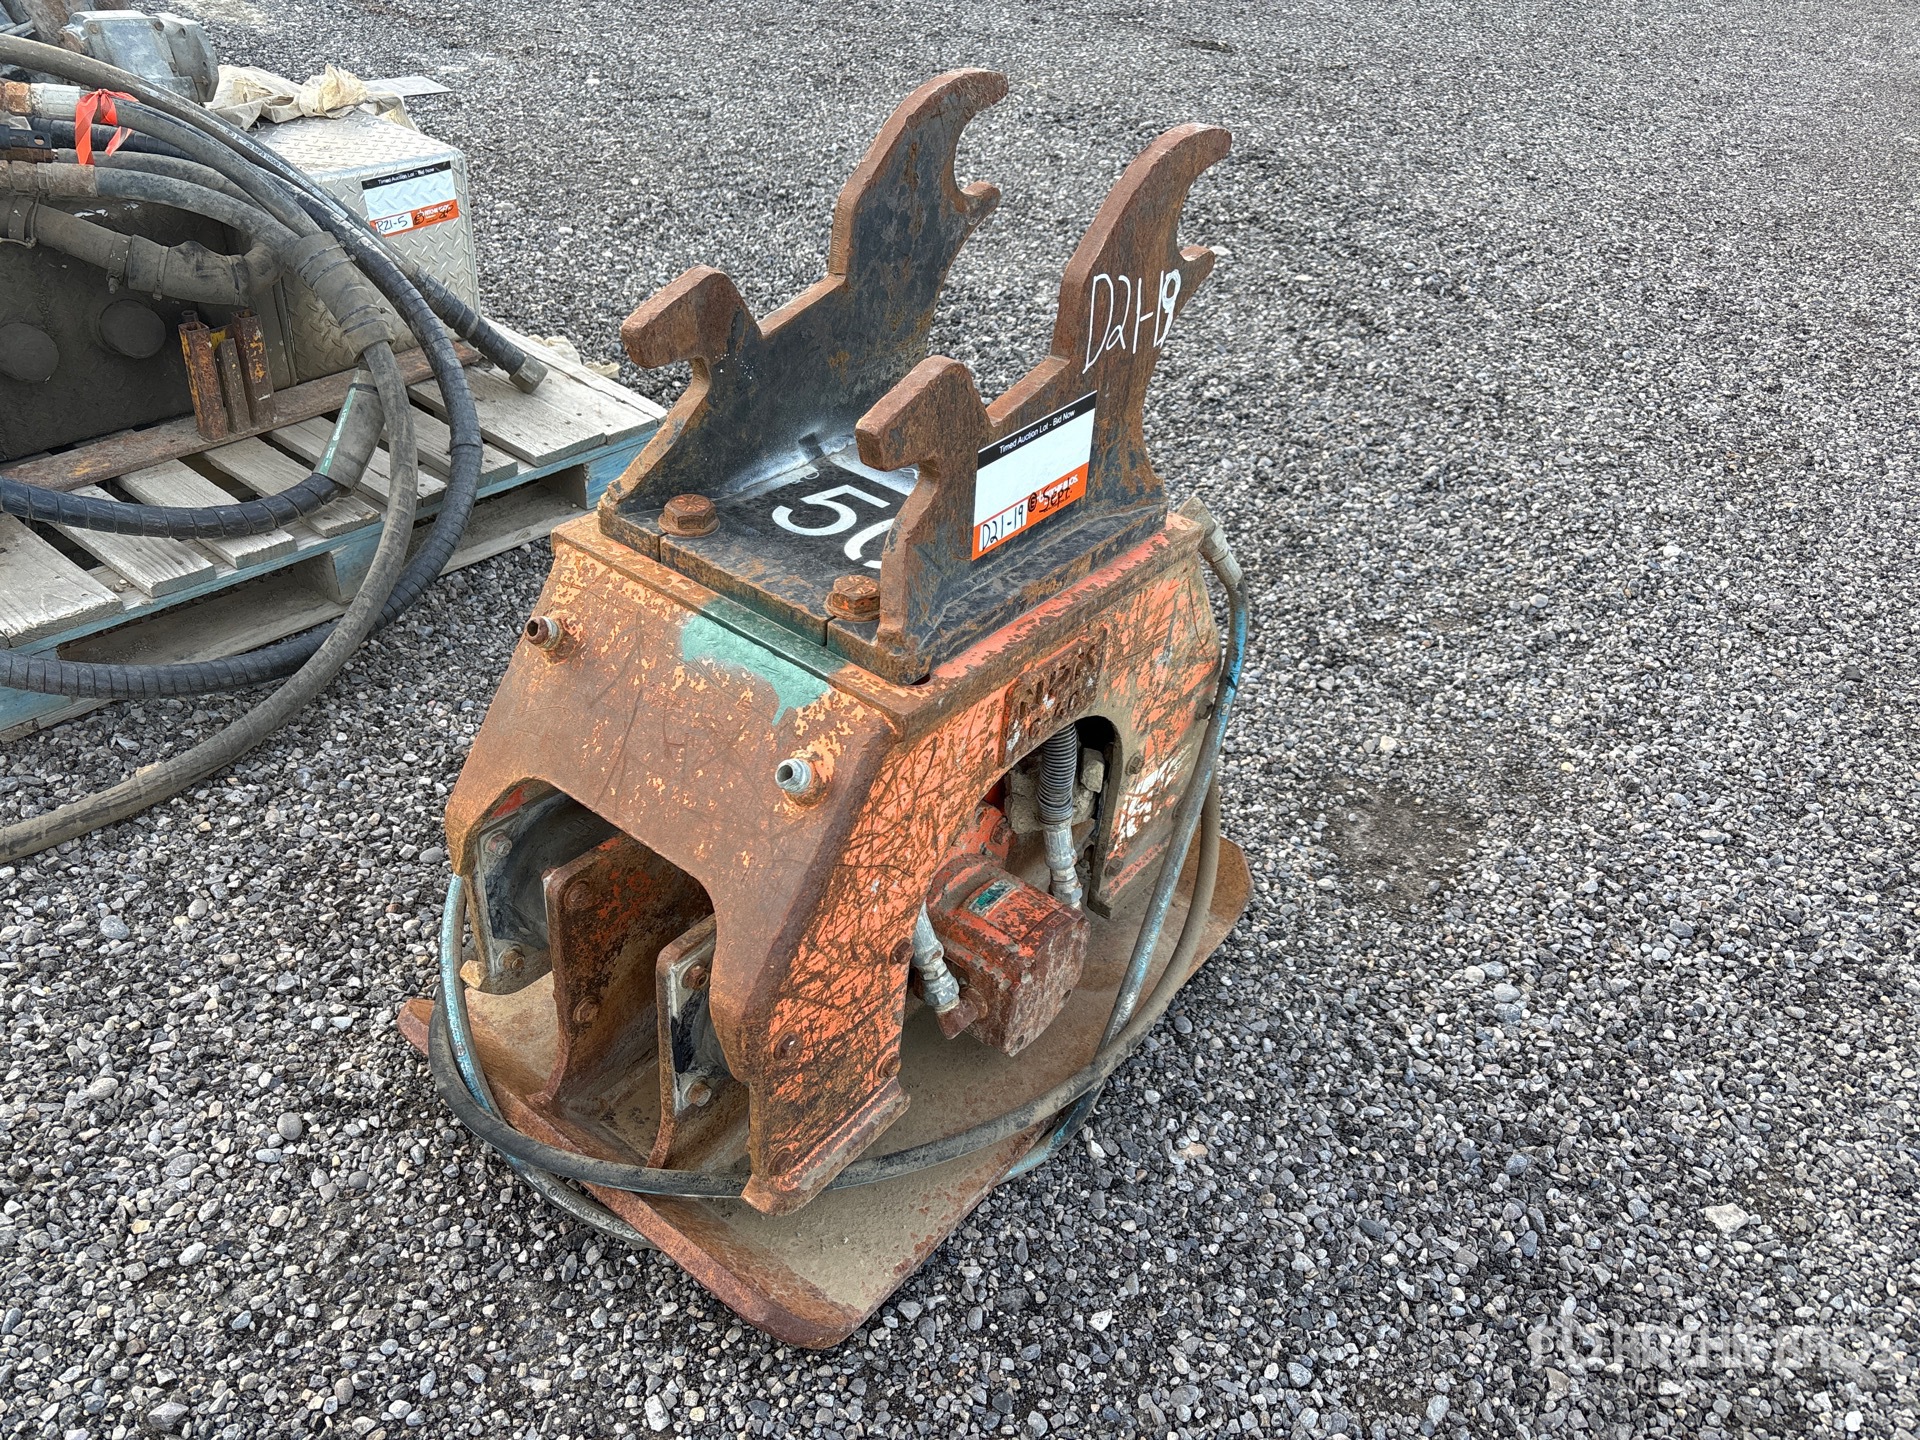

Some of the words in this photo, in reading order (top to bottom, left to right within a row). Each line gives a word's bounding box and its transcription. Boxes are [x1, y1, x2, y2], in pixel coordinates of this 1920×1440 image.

[391, 173, 408, 182] Auction
[999, 437, 1018, 454] Timed
[1018, 428, 1039, 444] Auction
[1039, 422, 1049, 434] Lot
[1053, 416, 1063, 428] Bid
[1063, 410, 1076, 423] Now
[982, 504, 1024, 552] D21-19
